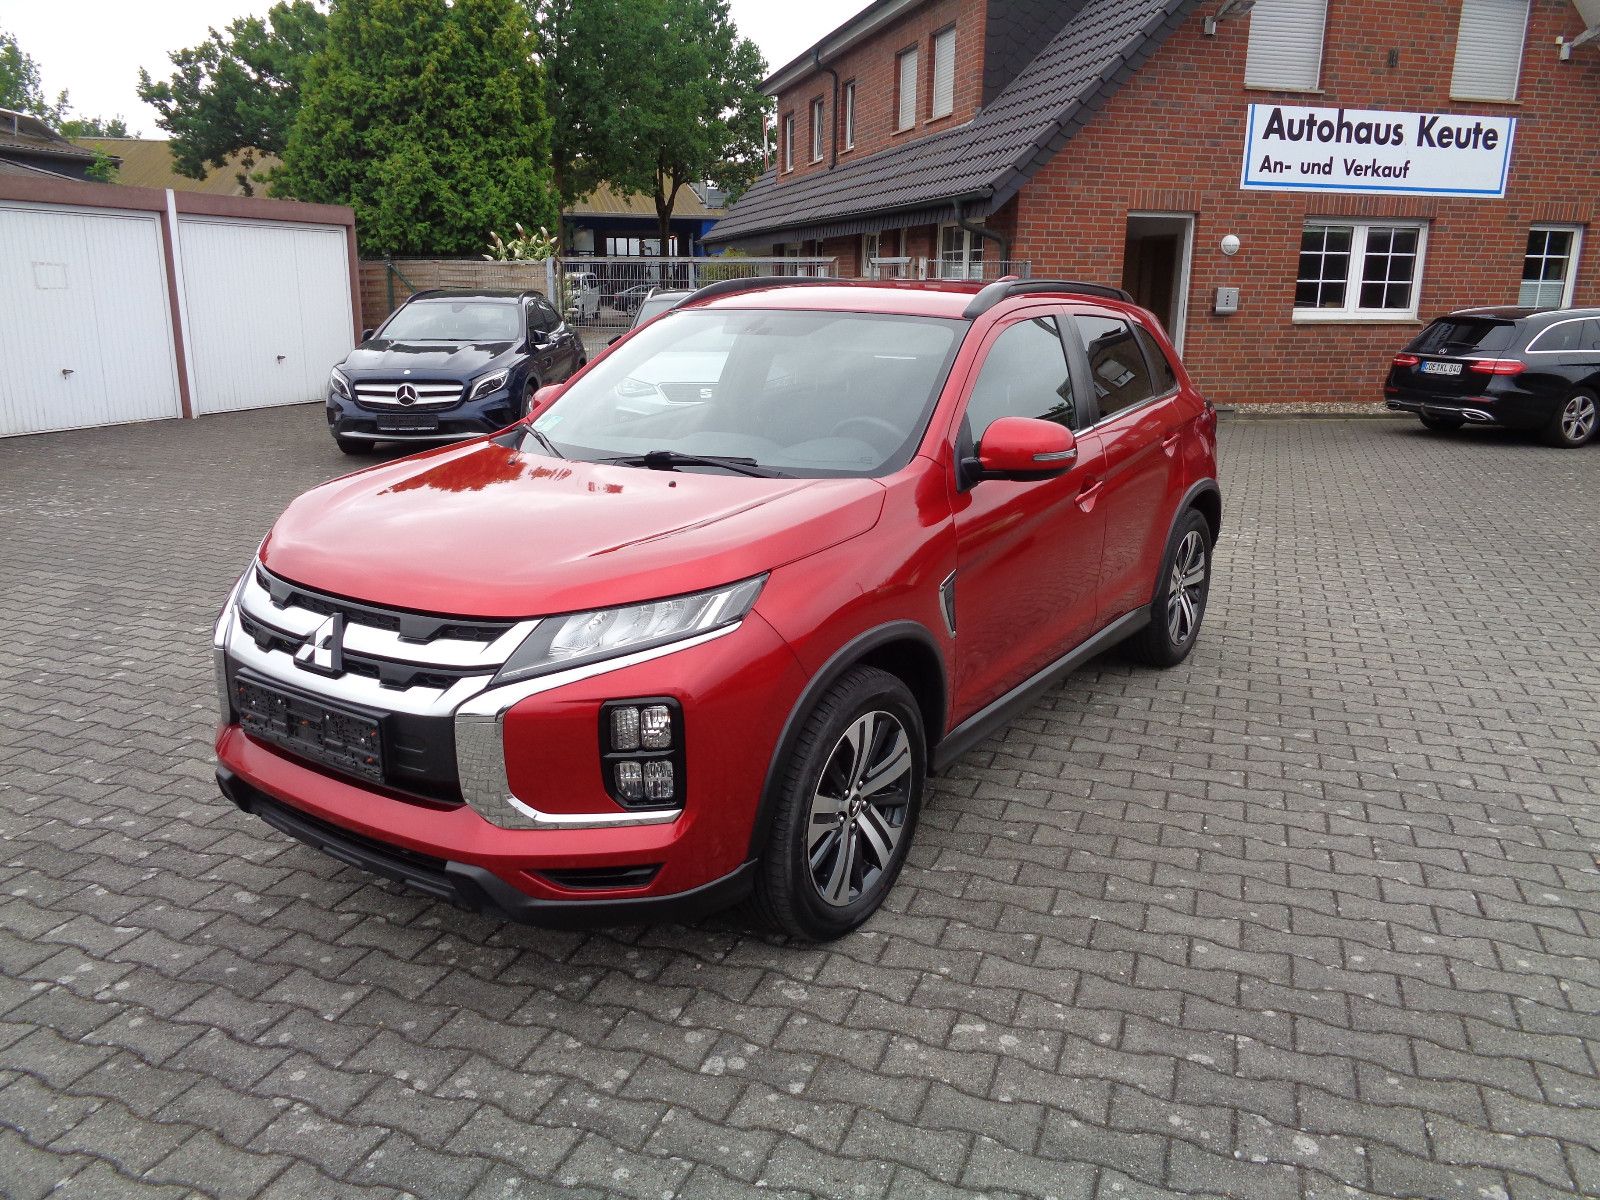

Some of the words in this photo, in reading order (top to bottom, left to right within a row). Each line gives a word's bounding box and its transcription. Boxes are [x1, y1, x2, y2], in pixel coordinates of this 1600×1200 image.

[1262, 107, 1404, 146] Autohaus
[1416, 115, 1499, 151] Keute
[1259, 155, 1292, 173] An-
[1300, 156, 1333, 175] und
[1343, 158, 1411, 179] Verkauf
